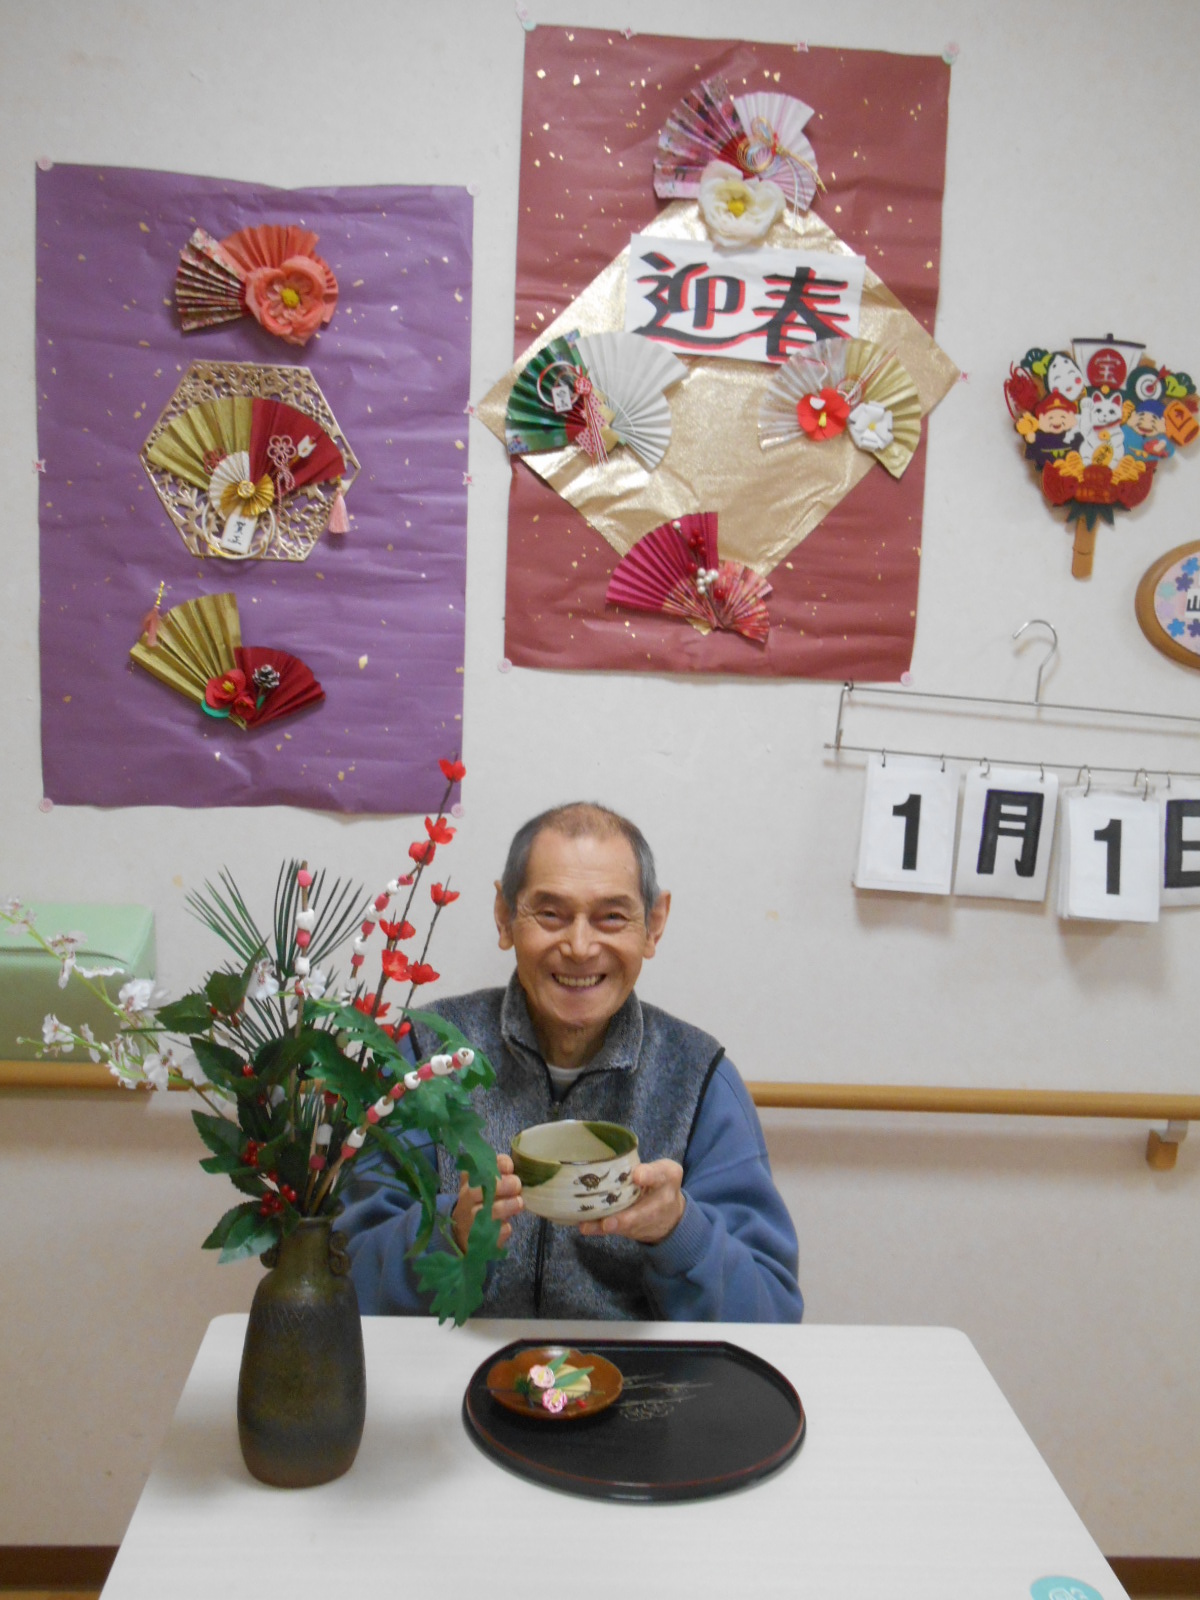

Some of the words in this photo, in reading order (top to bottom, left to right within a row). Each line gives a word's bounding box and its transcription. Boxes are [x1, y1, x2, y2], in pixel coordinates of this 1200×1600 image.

[632, 251, 852, 363] 迎春
[1094, 353, 1121, 384] 宝
[892, 793, 922, 871] 1
[976, 788, 1045, 877] 月
